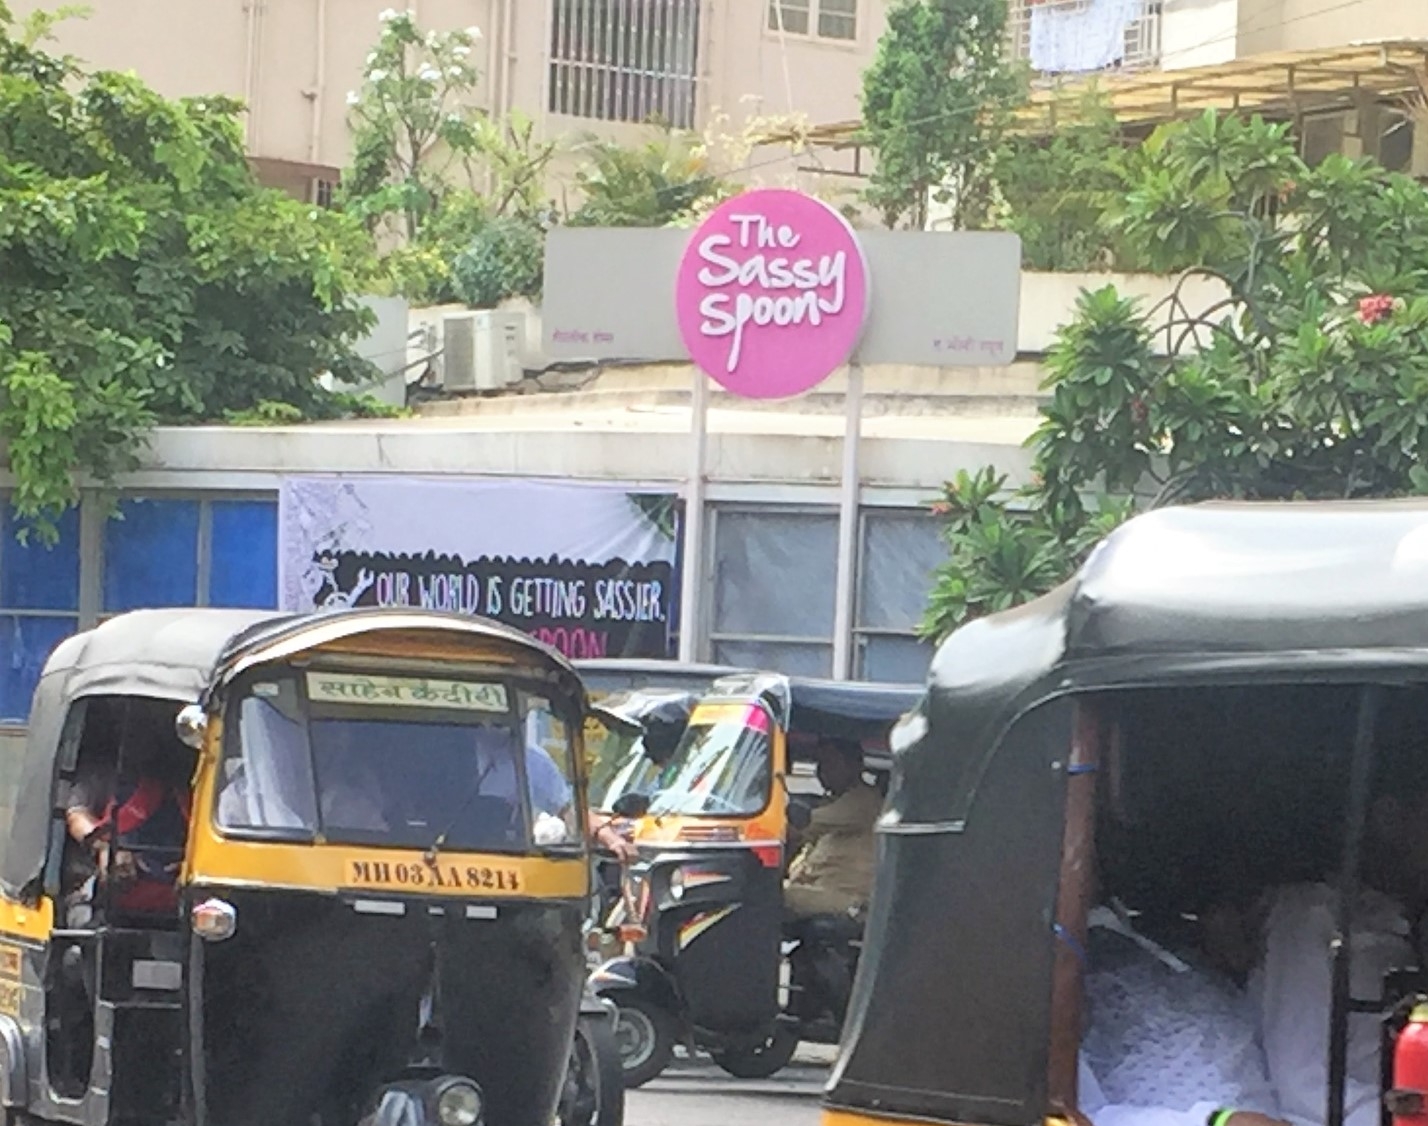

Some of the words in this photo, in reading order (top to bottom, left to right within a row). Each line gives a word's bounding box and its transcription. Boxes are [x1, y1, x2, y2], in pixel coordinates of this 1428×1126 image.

[729, 213, 800, 248] The
[697, 232, 846, 314] Sassy
[699, 290, 821, 373] Spoon
[376, 571, 410, 608] OUR
[418, 573, 480, 615] WORLD
[486, 575, 503, 615] IS
[509, 577, 586, 619] GETTING
